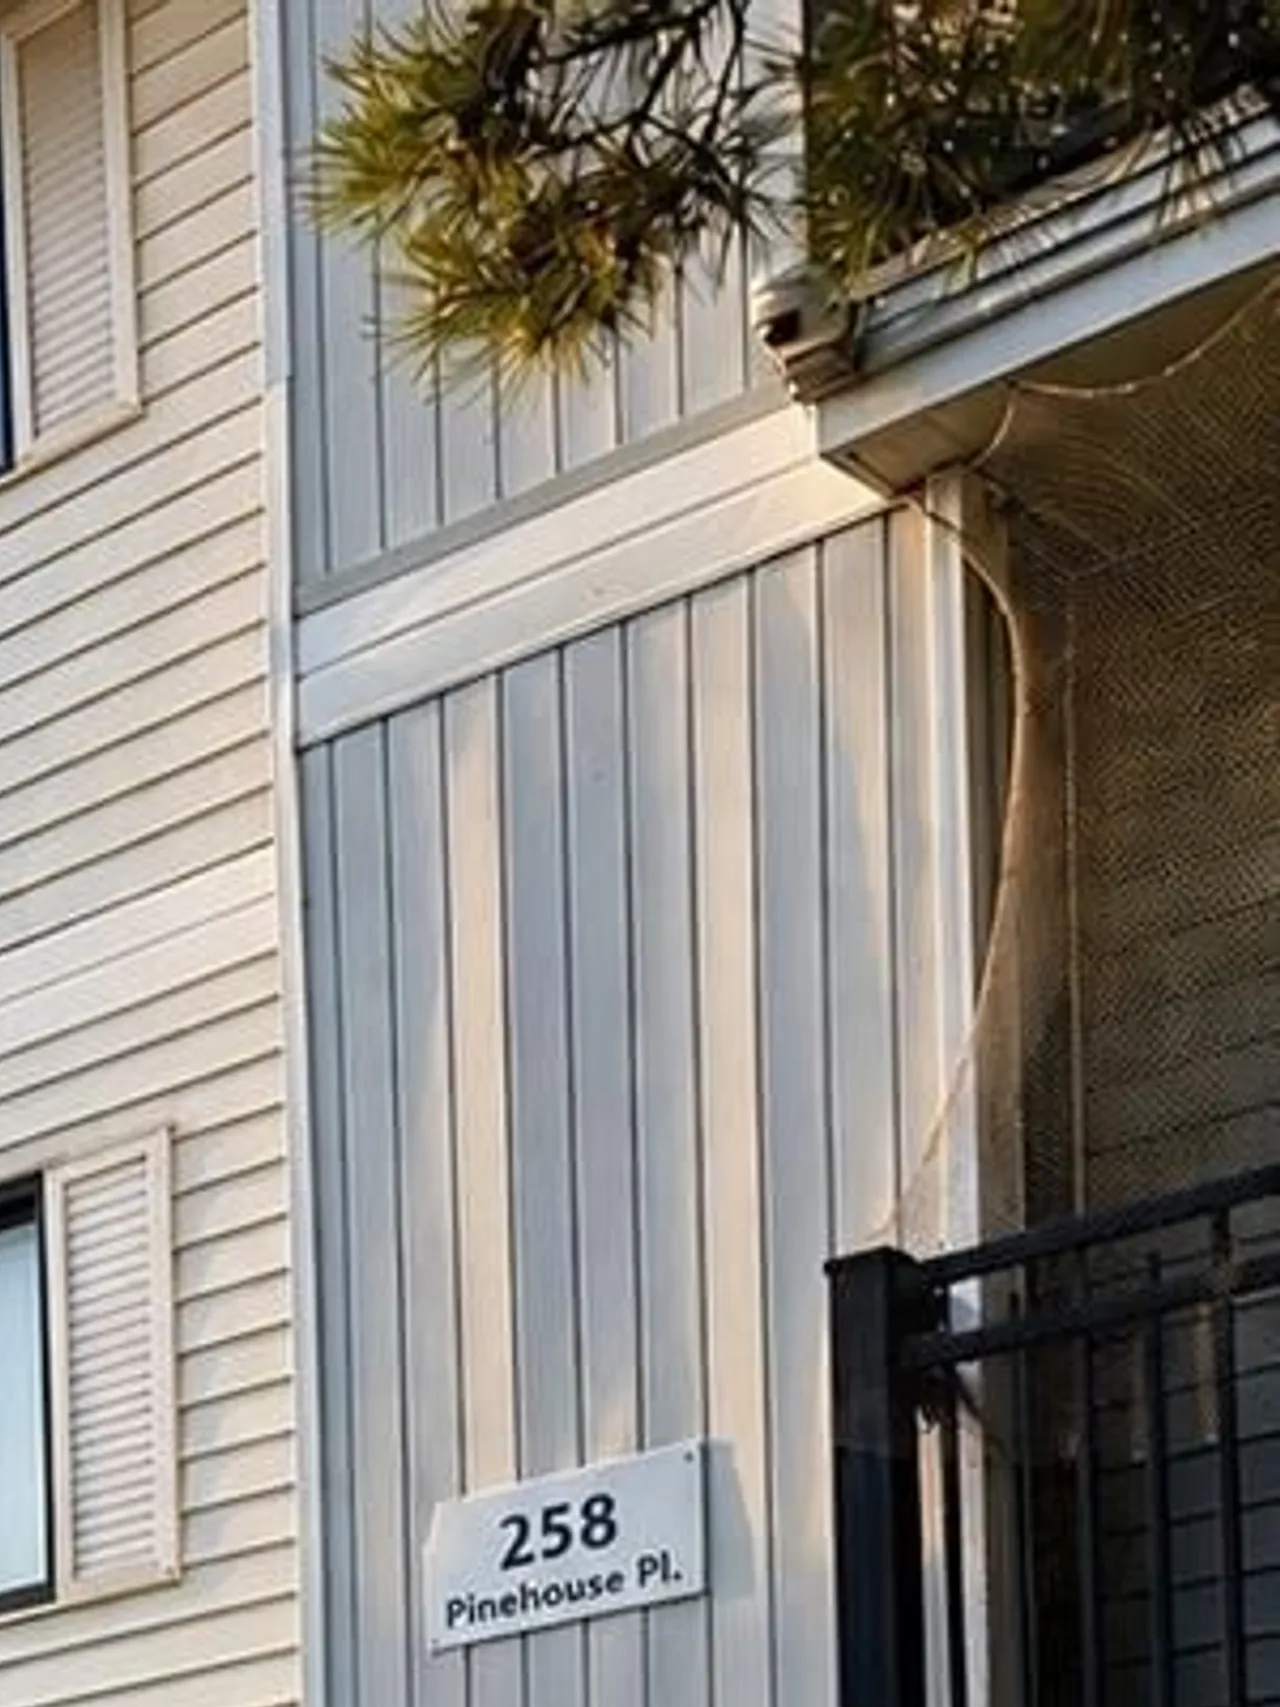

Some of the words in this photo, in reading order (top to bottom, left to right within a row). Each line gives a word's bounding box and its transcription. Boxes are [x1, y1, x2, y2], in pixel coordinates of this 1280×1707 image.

[499, 1492, 618, 1572] 258
[446, 1568, 624, 1630] Pinehouse
[636, 1549, 684, 1588] Pl.
